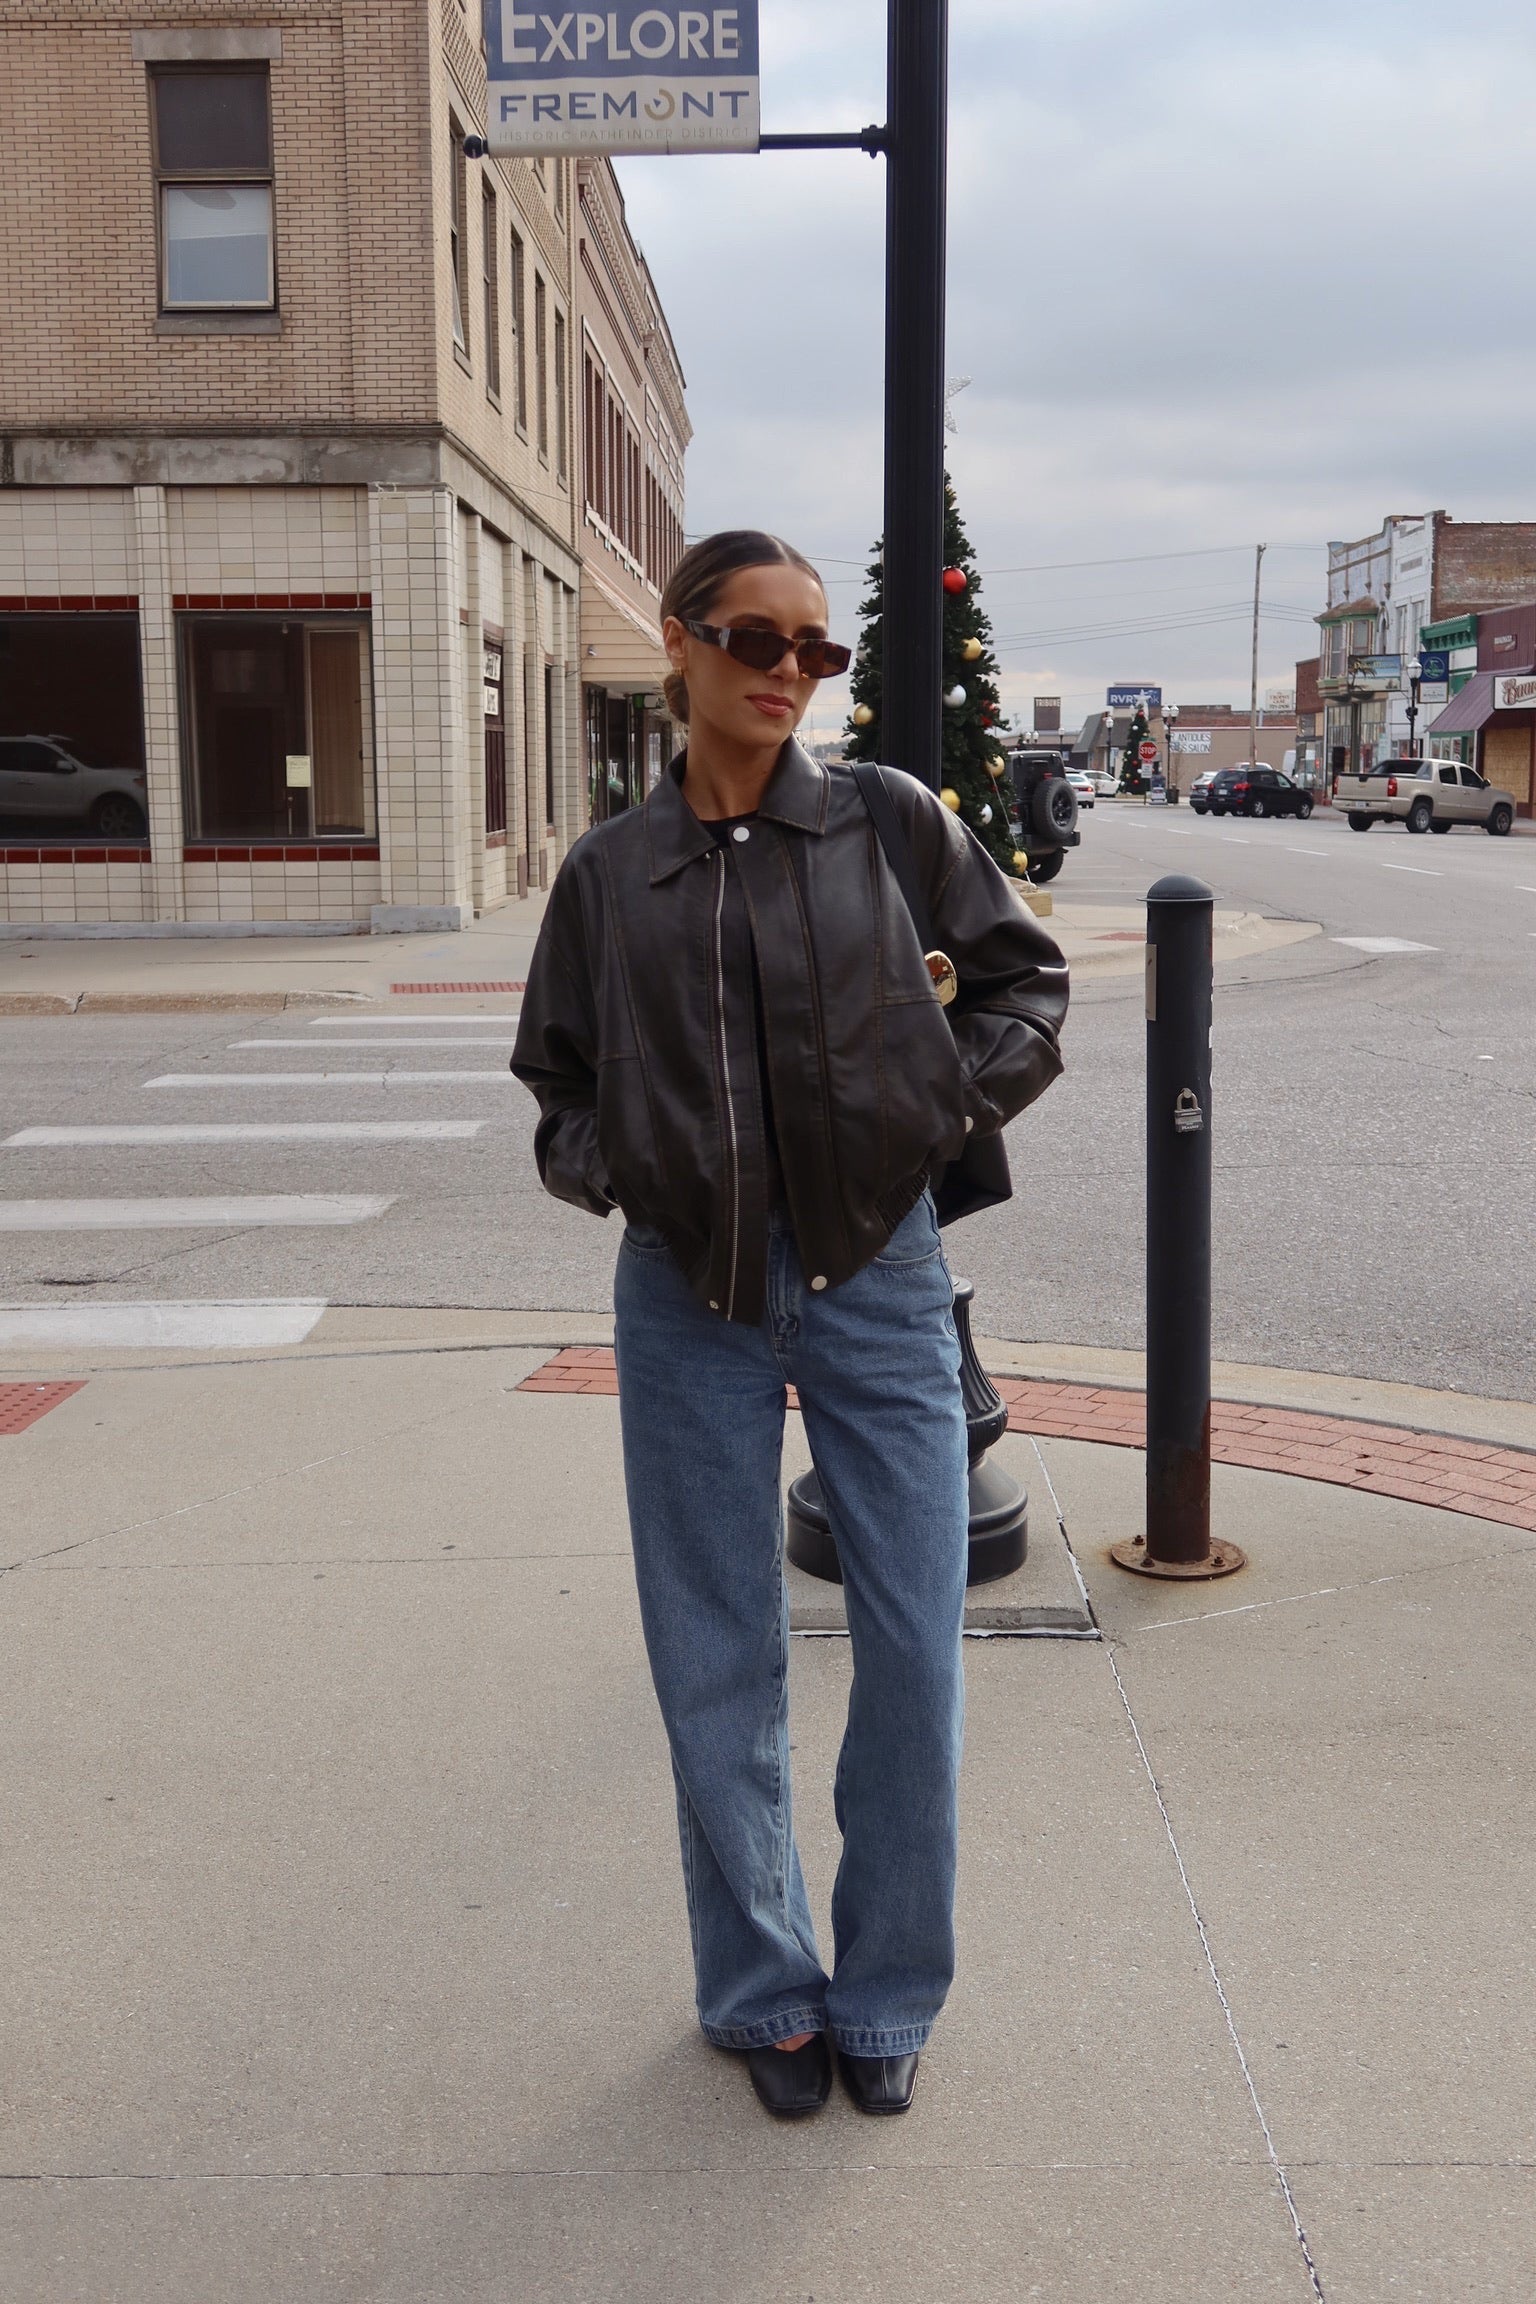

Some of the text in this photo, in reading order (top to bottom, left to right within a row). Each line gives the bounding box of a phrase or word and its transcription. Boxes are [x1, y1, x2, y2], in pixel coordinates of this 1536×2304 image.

[501, 0, 740, 63] EXPLORE
[500, 88, 750, 122] FREMONT
[499, 126, 749, 142] HISTORIC PATHFINDER DISTRICT
[1178, 732, 1211, 742] ANTIQUES
[1140, 746, 1156, 754] STOP
[1188, 743, 1211, 753] SALON
